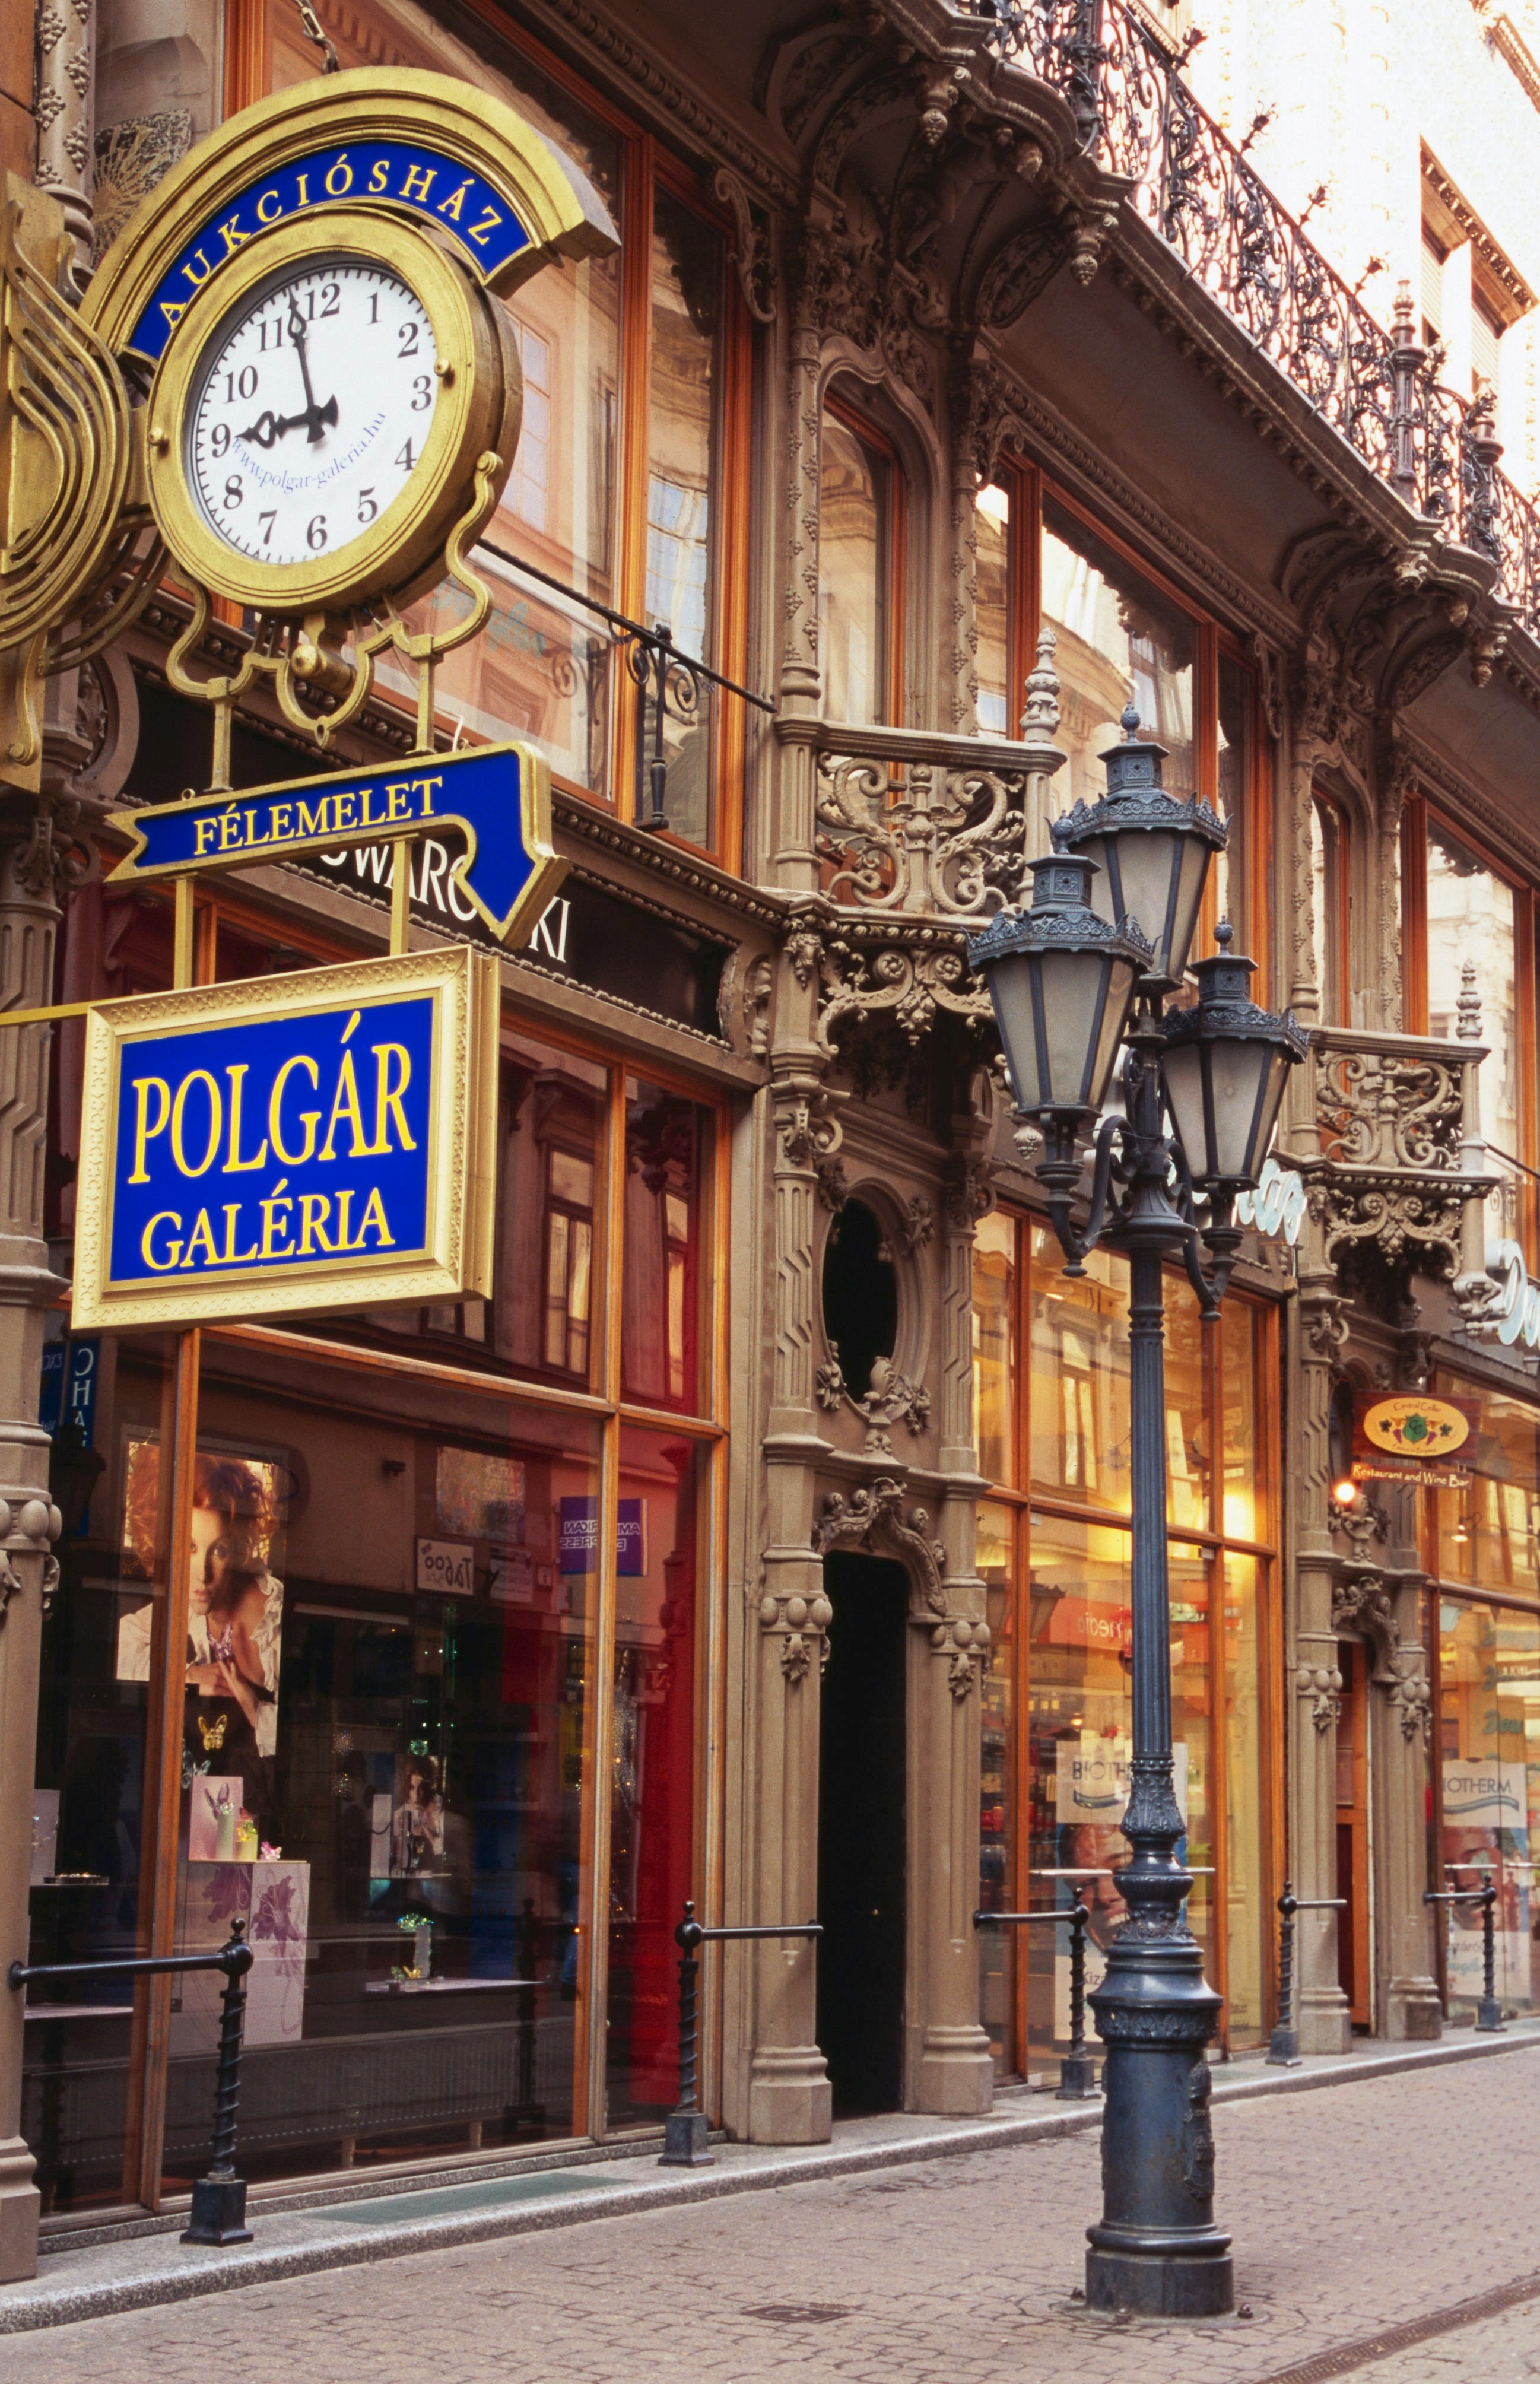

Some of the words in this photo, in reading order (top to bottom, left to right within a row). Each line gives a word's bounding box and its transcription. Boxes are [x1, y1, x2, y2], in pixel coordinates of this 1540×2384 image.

[160, 153, 503, 331] AUKCIÓSHÁZ
[304, 282, 341, 321] 12
[365, 292, 381, 325] 1
[255, 316, 286, 354] 11
[397, 322, 419, 358] 2
[222, 366, 259, 404] 10
[410, 375, 433, 411] 3
[211, 423, 231, 458] 9
[394, 437, 417, 472] 4
[223, 474, 244, 510] 8
[357, 487, 380, 525] 5
[257, 509, 278, 545] 7
[306, 515, 328, 551] 6
[194, 776, 442, 855] FÉLEMELET
[128, 1011, 417, 1184] POLGÁR
[141, 1178, 396, 1271] GALÉRIA
[1352, 1464, 1403, 1480] Restaurant
[1404, 1471, 1422, 1482] and
[1423, 1471, 1447, 1485] Wine
[1449, 1474, 1470, 1488] Bar
